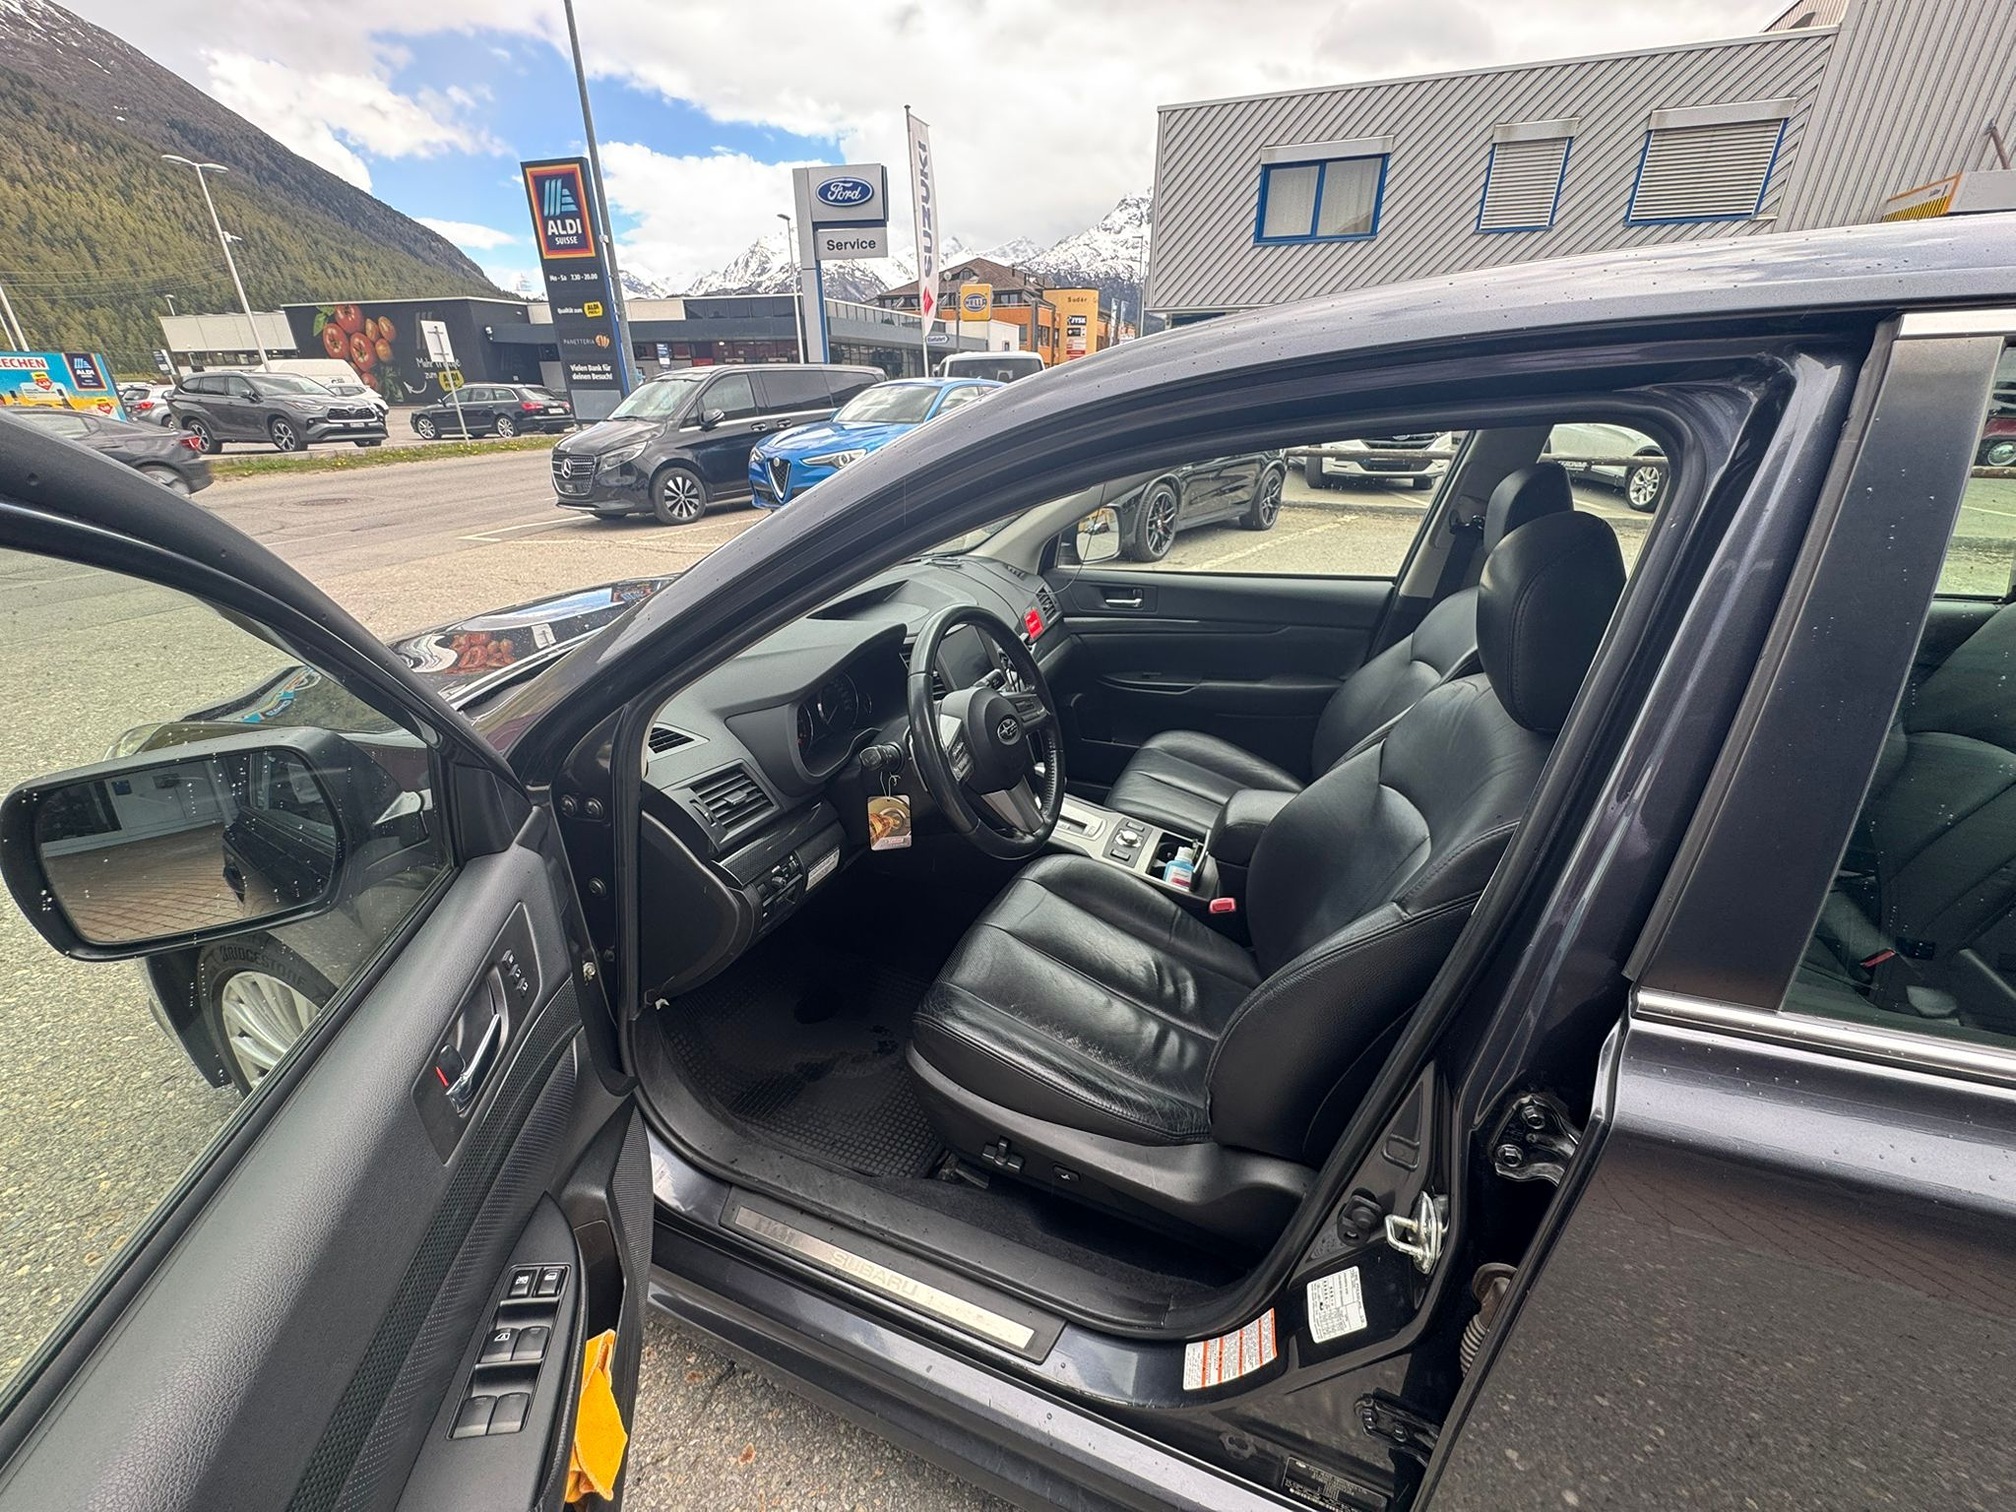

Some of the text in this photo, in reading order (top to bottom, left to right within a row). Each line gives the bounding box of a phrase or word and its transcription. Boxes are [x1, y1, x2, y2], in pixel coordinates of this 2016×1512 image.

[827, 182, 861, 200] Ford
[918, 140, 933, 278] SUZUKI
[547, 219, 582, 236] ALDI
[555, 236, 578, 245] SUISSE
[826, 238, 877, 251] Service
[0, 358, 46, 368] ECHEN
[829, 1250, 919, 1296] SUBARU
